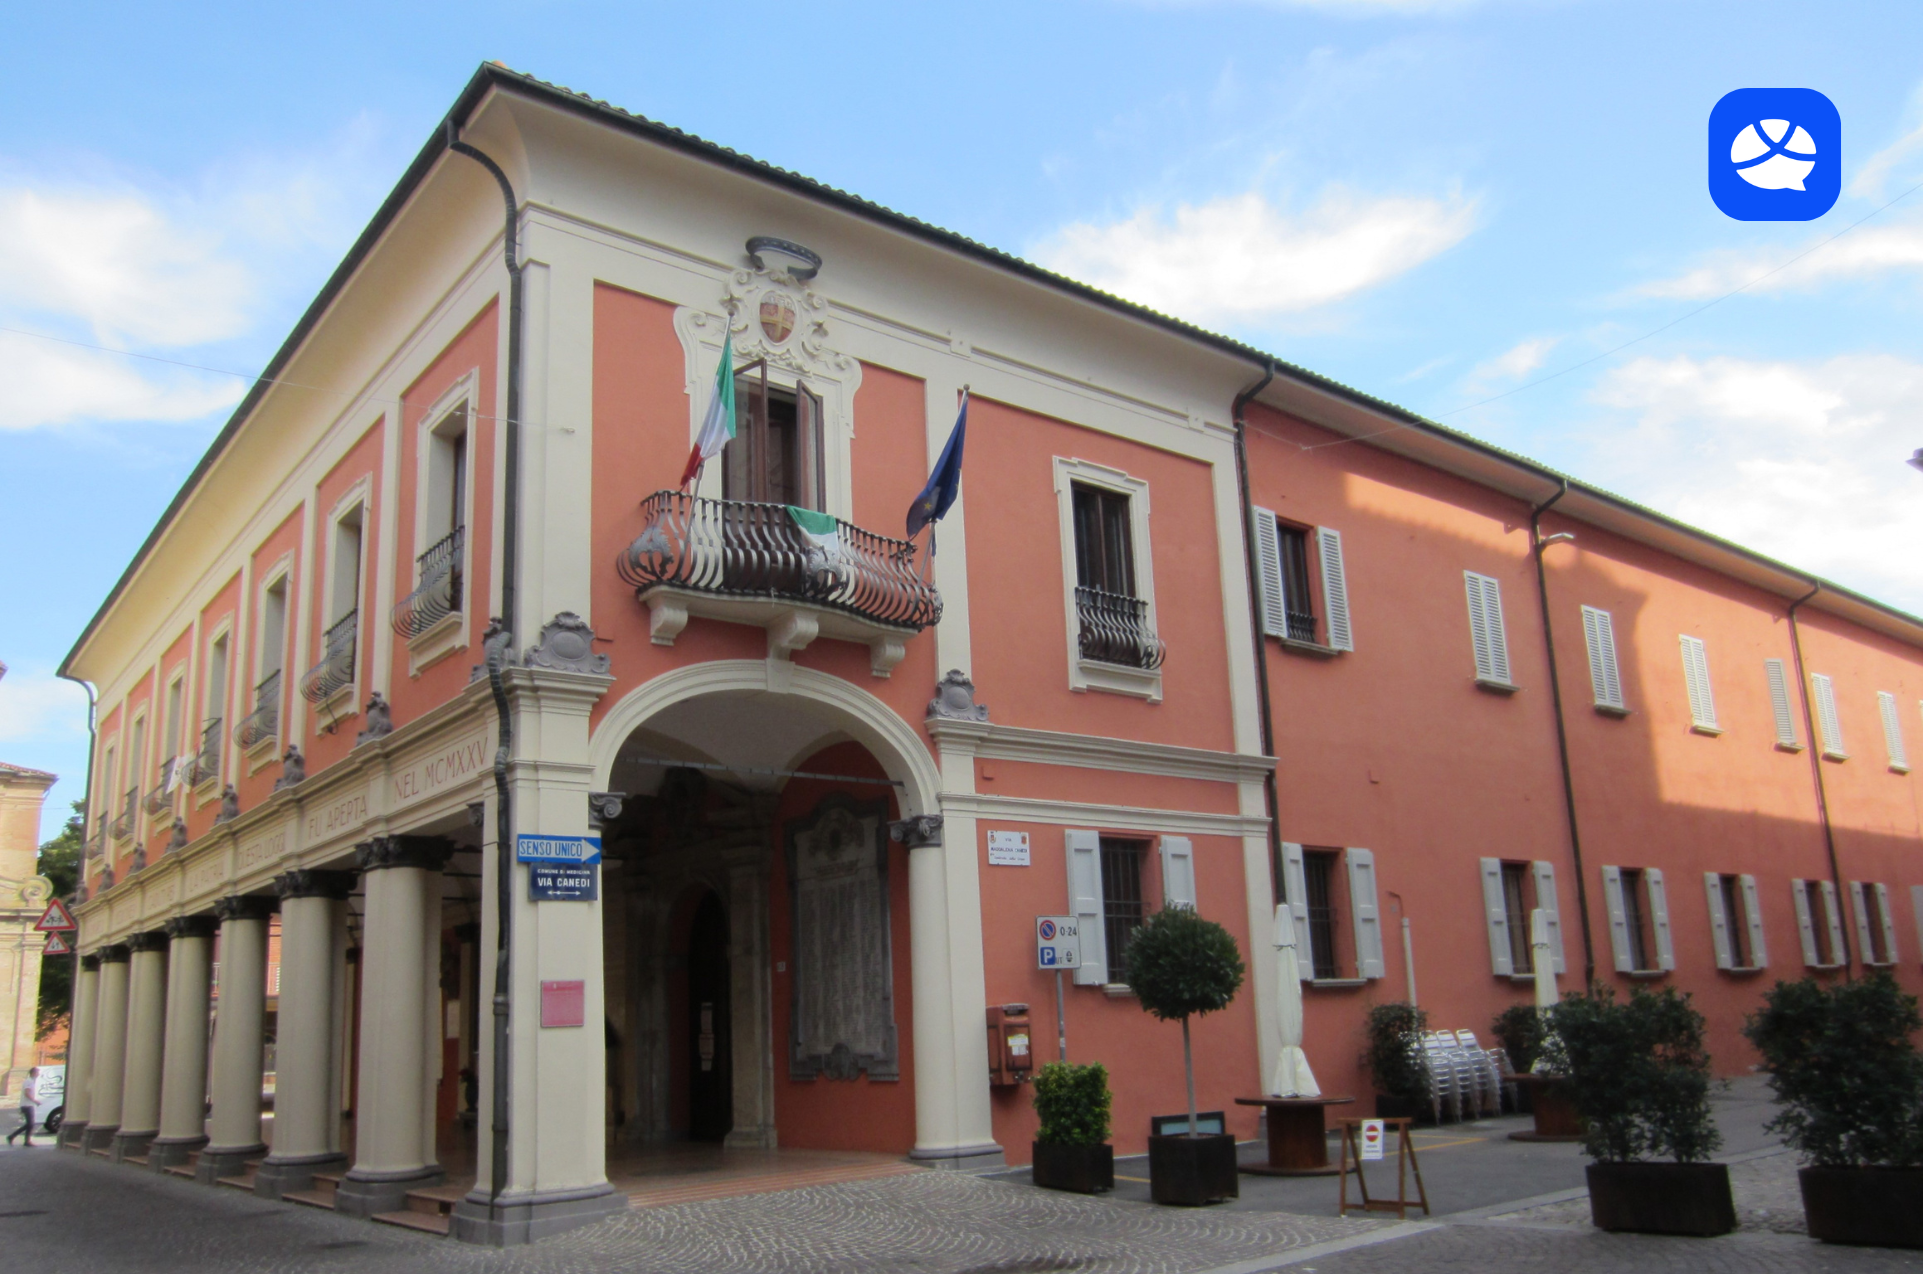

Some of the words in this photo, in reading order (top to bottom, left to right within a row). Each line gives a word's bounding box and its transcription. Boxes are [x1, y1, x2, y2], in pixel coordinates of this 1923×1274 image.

[394, 771, 420, 803] NEL
[424, 737, 488, 790] MCMXXV
[308, 815, 322, 840] FU
[520, 841, 552, 856] SENSO
[554, 843, 582, 857] UNICO
[537, 877, 553, 887] VIA
[556, 878, 590, 888] CANEDI
[1043, 948, 1053, 963] P
